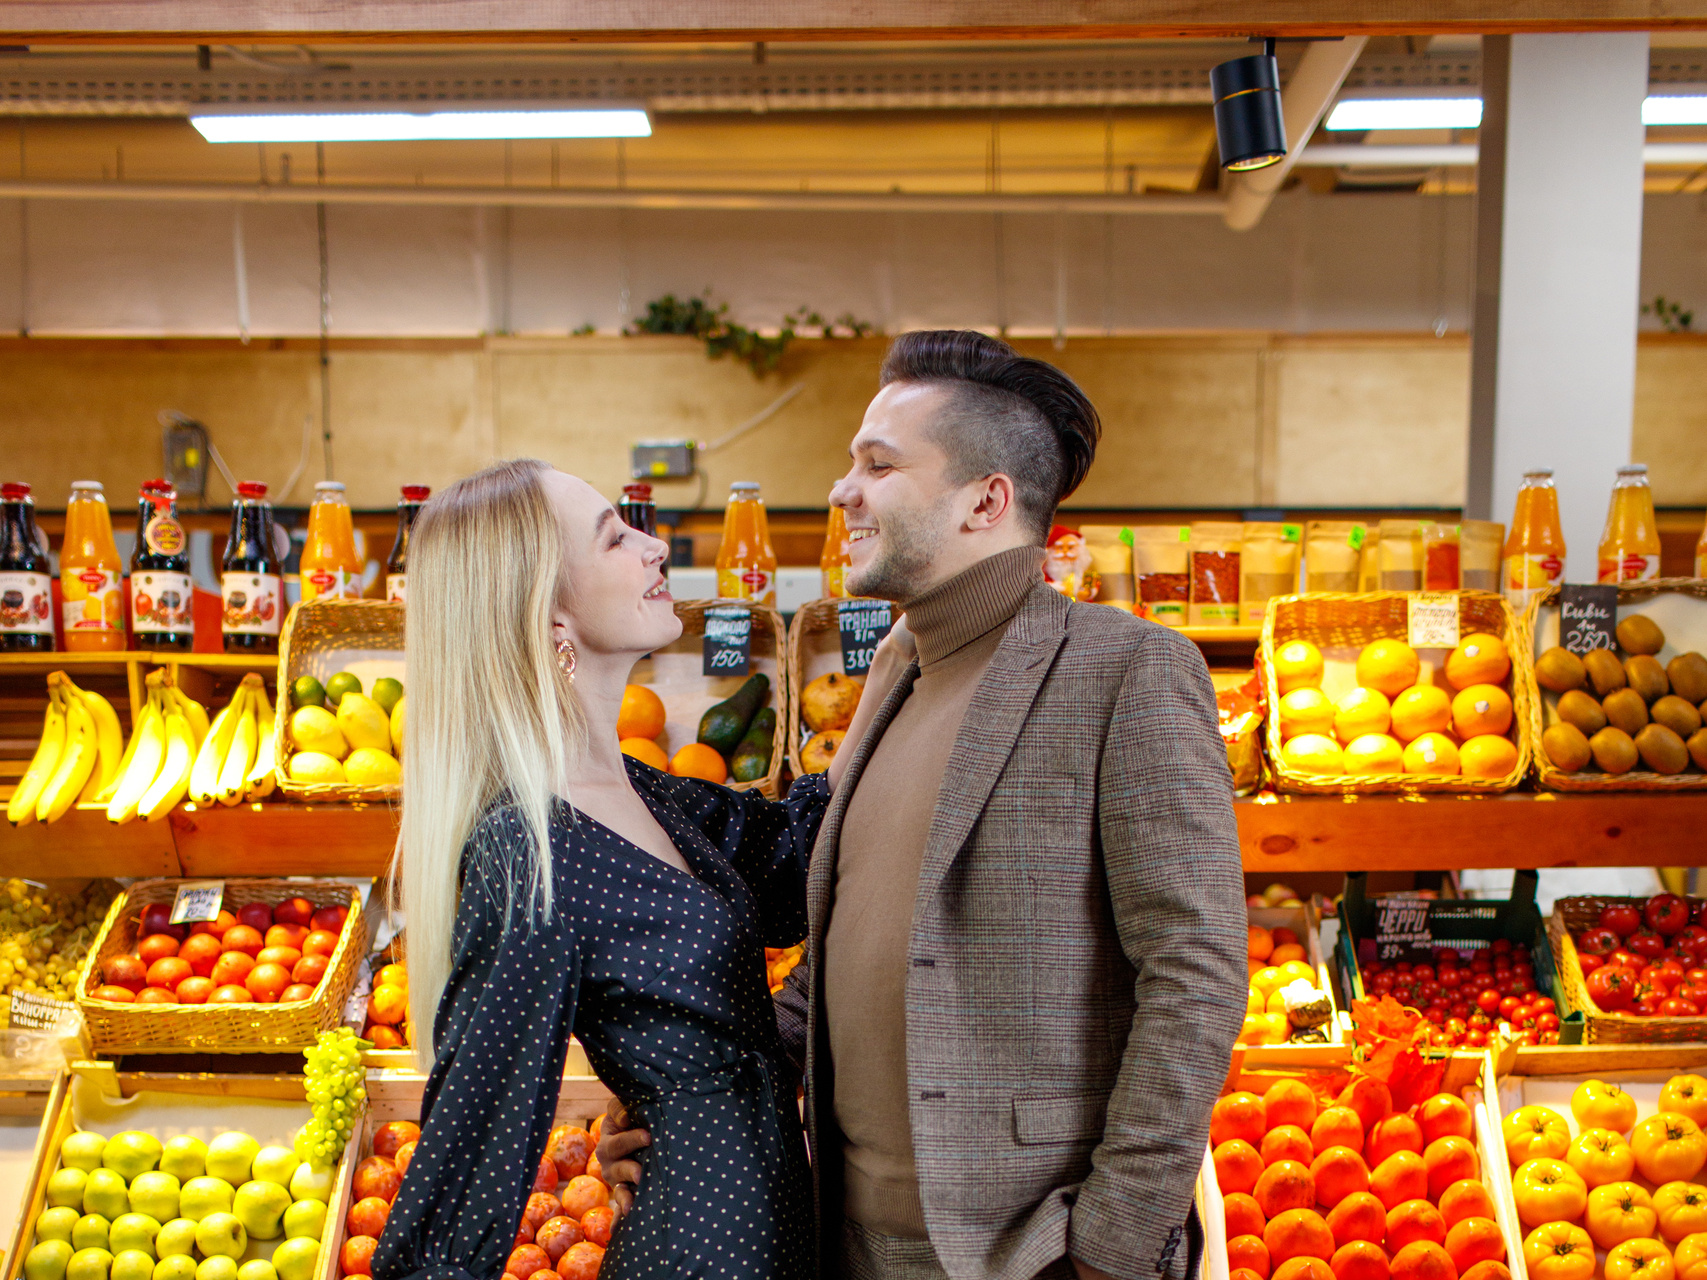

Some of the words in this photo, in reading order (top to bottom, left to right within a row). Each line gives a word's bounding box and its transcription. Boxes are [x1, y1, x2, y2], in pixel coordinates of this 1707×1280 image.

[839, 607, 891, 632] ГРАНАТ
[1561, 601, 1610, 619] Киви
[846, 648, 876, 670] 380
[1379, 909, 1427, 933] ЧЕРРИ
